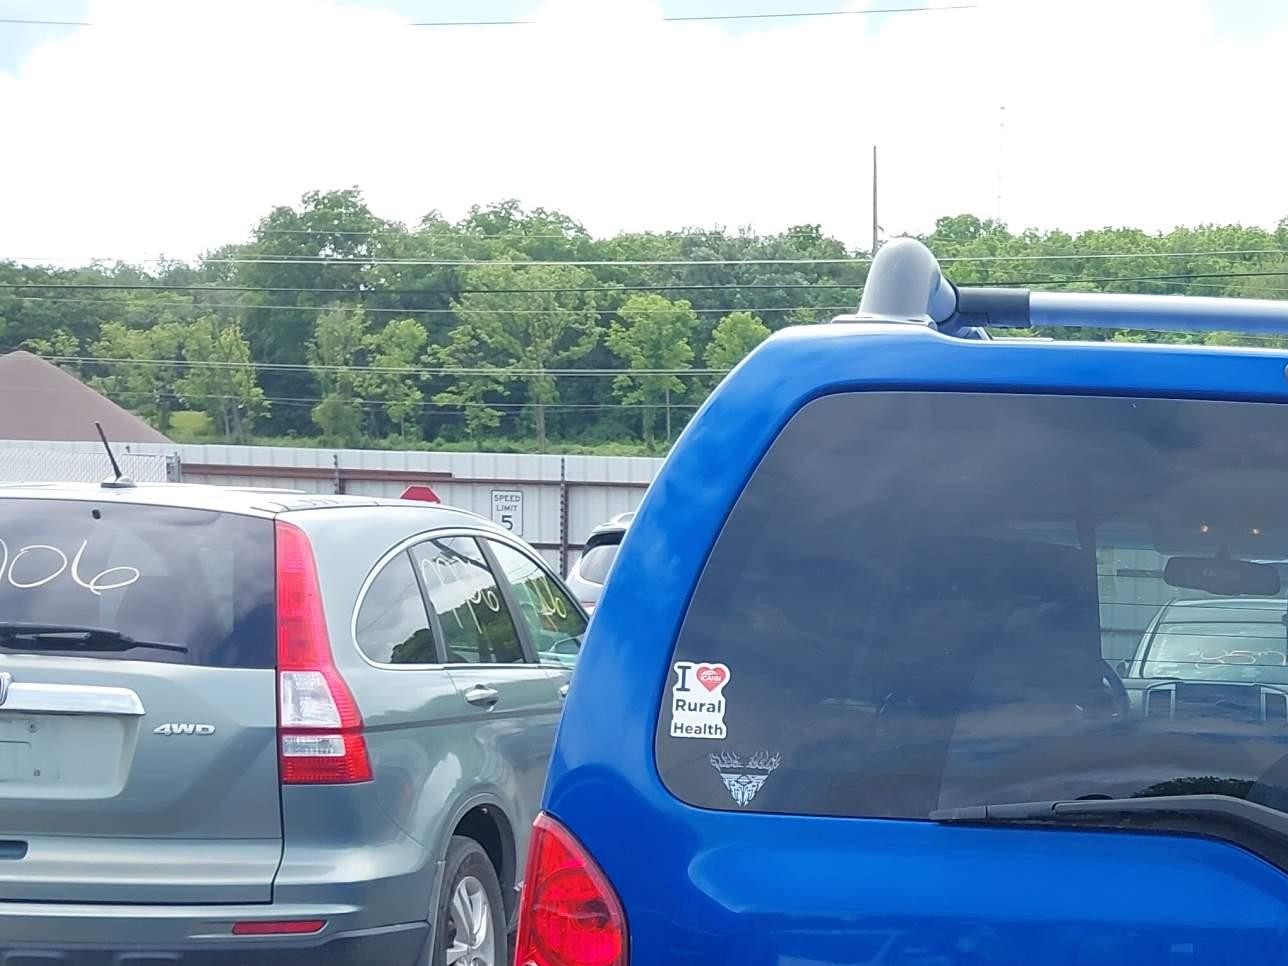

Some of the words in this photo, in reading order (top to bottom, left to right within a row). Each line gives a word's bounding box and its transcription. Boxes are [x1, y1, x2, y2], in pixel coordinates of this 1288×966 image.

[493, 494, 521, 502] SPEED
[501, 515, 513, 531] 5
[675, 665, 692, 692] I
[675, 699, 722, 713] Rural
[153, 722, 216, 736] 4WD
[673, 722, 723, 736] Health
